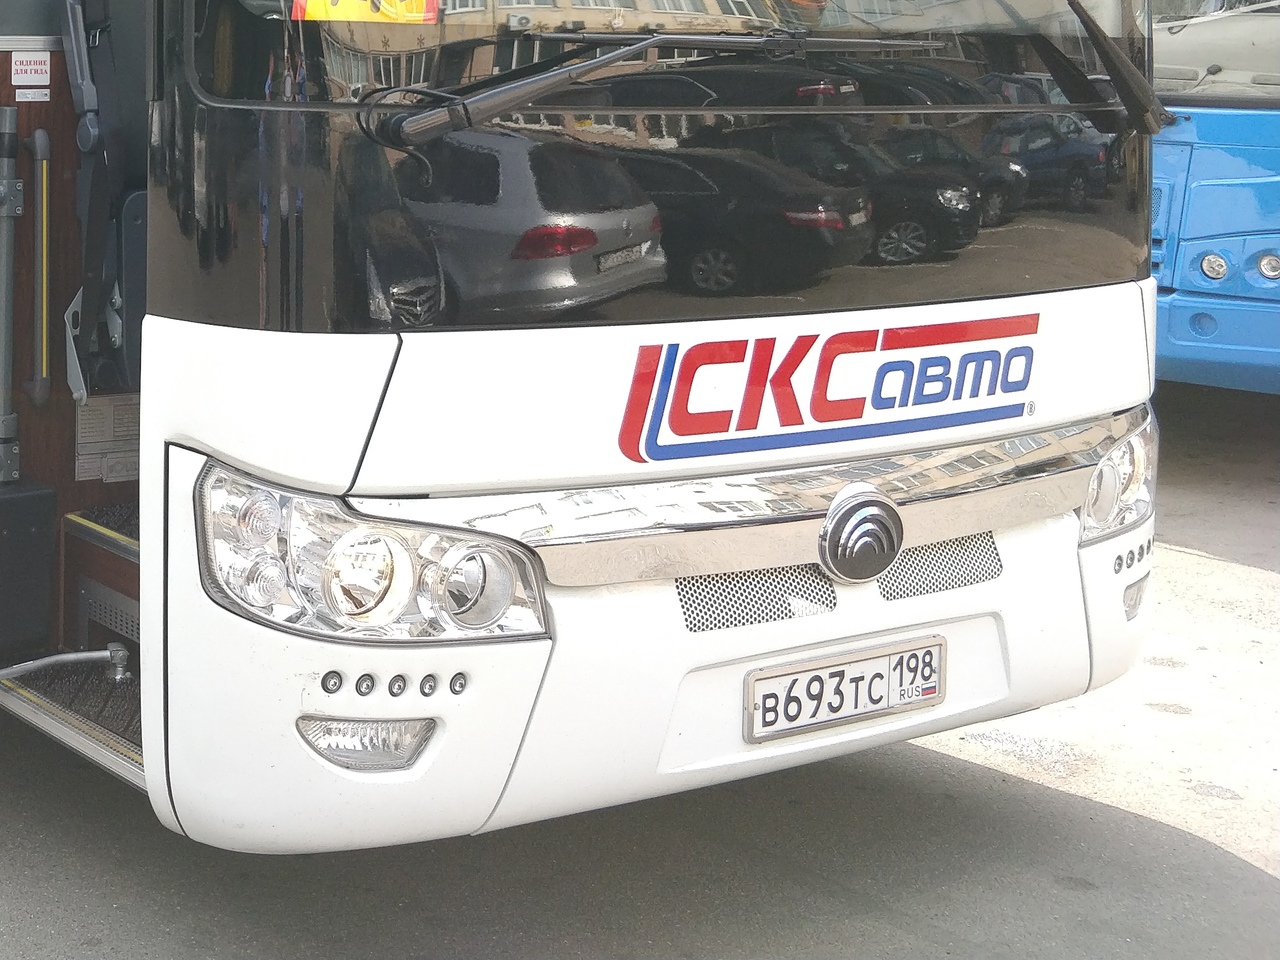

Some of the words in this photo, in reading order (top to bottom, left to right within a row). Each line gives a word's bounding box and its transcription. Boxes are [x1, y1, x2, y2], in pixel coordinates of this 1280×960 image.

[13, 68, 28, 76] ДЛЯ
[761, 670, 885, 728] В693ТС
[892, 649, 934, 688] 198
[899, 685, 921, 701] RUS
